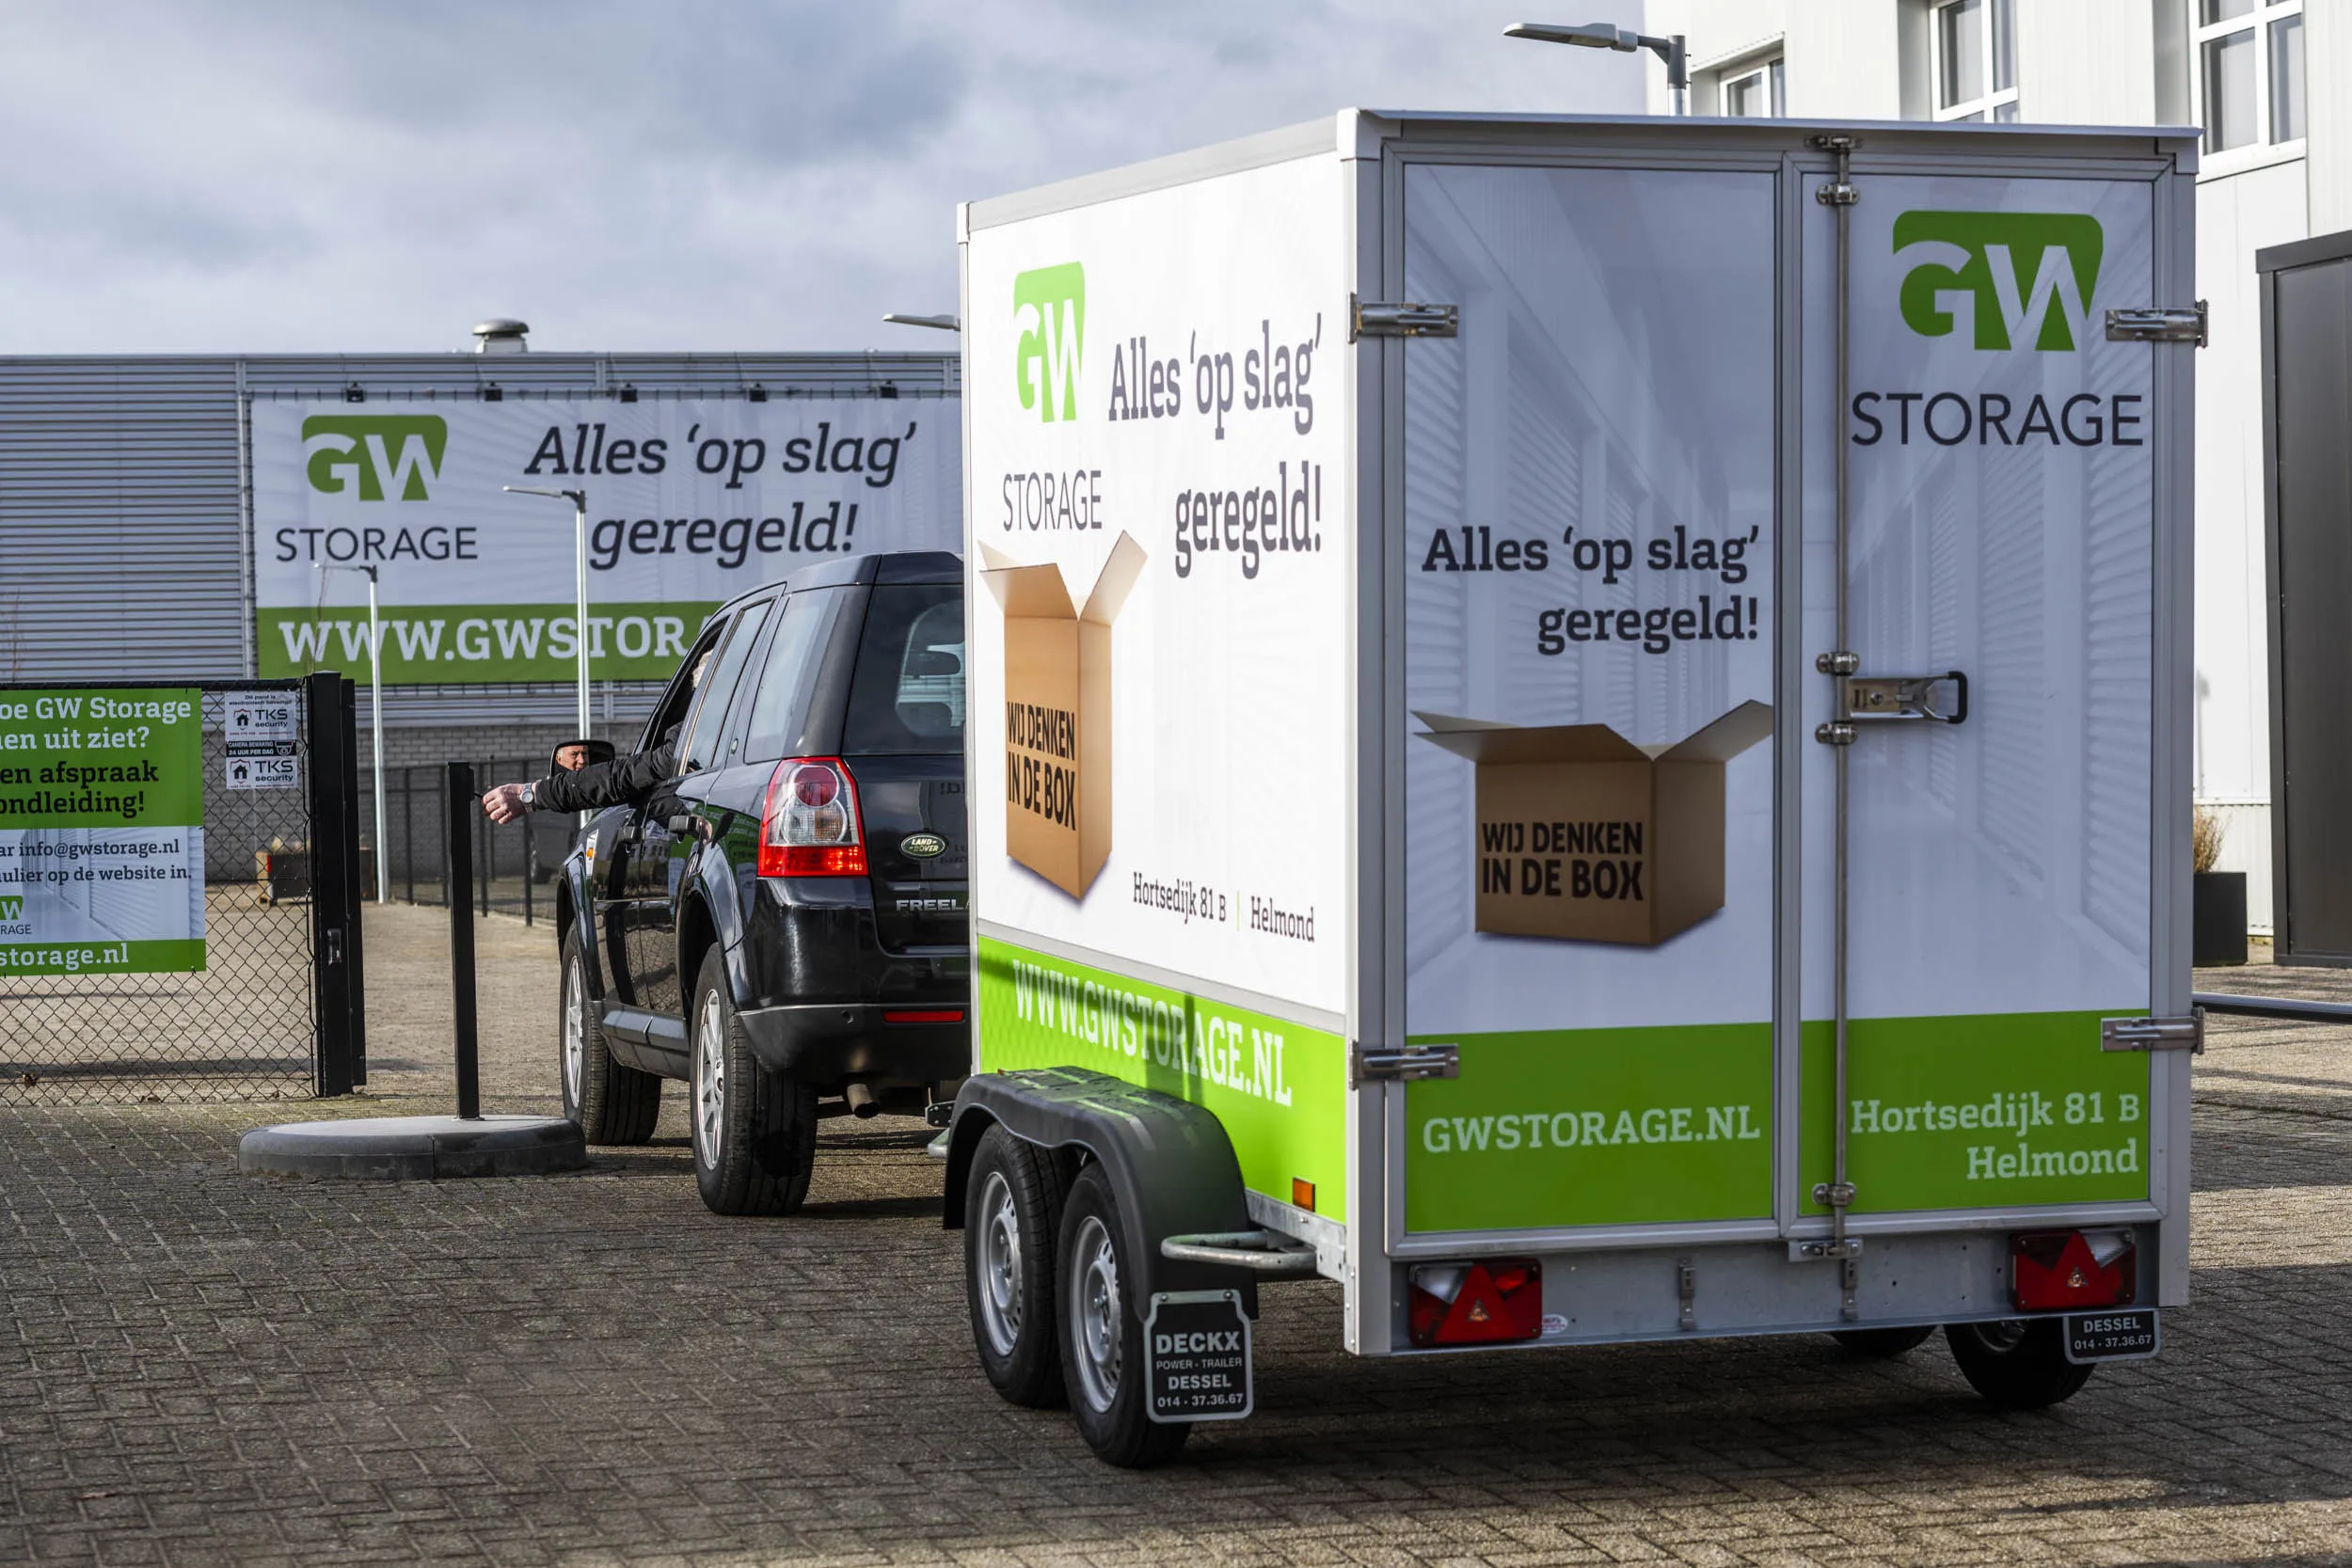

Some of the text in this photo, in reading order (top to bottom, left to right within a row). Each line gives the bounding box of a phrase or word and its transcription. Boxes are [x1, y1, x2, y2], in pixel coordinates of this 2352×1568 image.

[1893, 238, 2099, 351] GW
[1013, 293, 1084, 422] GW
[1109, 312, 1322, 440] Alles ‘op slag’
[1851, 391, 2143, 447] STORAGE
[302, 430, 443, 501] GW
[524, 421, 917, 488] Alles ‘op slag’
[1003, 469, 1103, 531] STORAGE
[1175, 460, 1321, 579] geregeld!
[275, 527, 478, 562] STORAGE
[590, 503, 859, 569] geregeld!
[1422, 525, 1759, 584] Alles ‘op slag’
[1537, 595, 1758, 656] geregeld!
[36, 697, 83, 719] GW
[89, 697, 191, 724] Storage
[255, 709, 288, 721] TKS
[1007, 701, 1075, 761] WIJ DENKEN
[44, 727, 81, 749] uit
[87, 726, 150, 749] ziet?
[40, 760, 159, 789] afspraak
[255, 760, 294, 773] TKS
[1008, 752, 1076, 832] IN DE BOX
[19, 839, 180, 860] info@gwstorage.nl
[1482, 821, 1643, 855] WIJ DENKEN
[0, 865, 192, 884] ulier op de website in.
[1482, 858, 1644, 901] IN DE BOX
[1133, 872, 1315, 942] Hortsedijk 81 B Helmond
[1012, 959, 1292, 1107] WWW.GWSTORAGE.NL
[1422, 1105, 1760, 1153] GWSTORAGE.NL
[1851, 1091, 2140, 1137] Hortsedijk 81 B
[1966, 1137, 2139, 1180] Helmond
[1155, 1331, 1240, 1354] DECKX
[2074, 1339, 2094, 1350] 014
[2106, 1335, 2152, 1348] 37.36.67
[2083, 1317, 2141, 1333] DESSEL
[1156, 1360, 1193, 1370] POWER
[1201, 1357, 1243, 1368] TRAILER
[1168, 1374, 1232, 1390] DESSEL
[1157, 1397, 1181, 1408] 014
[1191, 1393, 1244, 1407] 37.36.67
